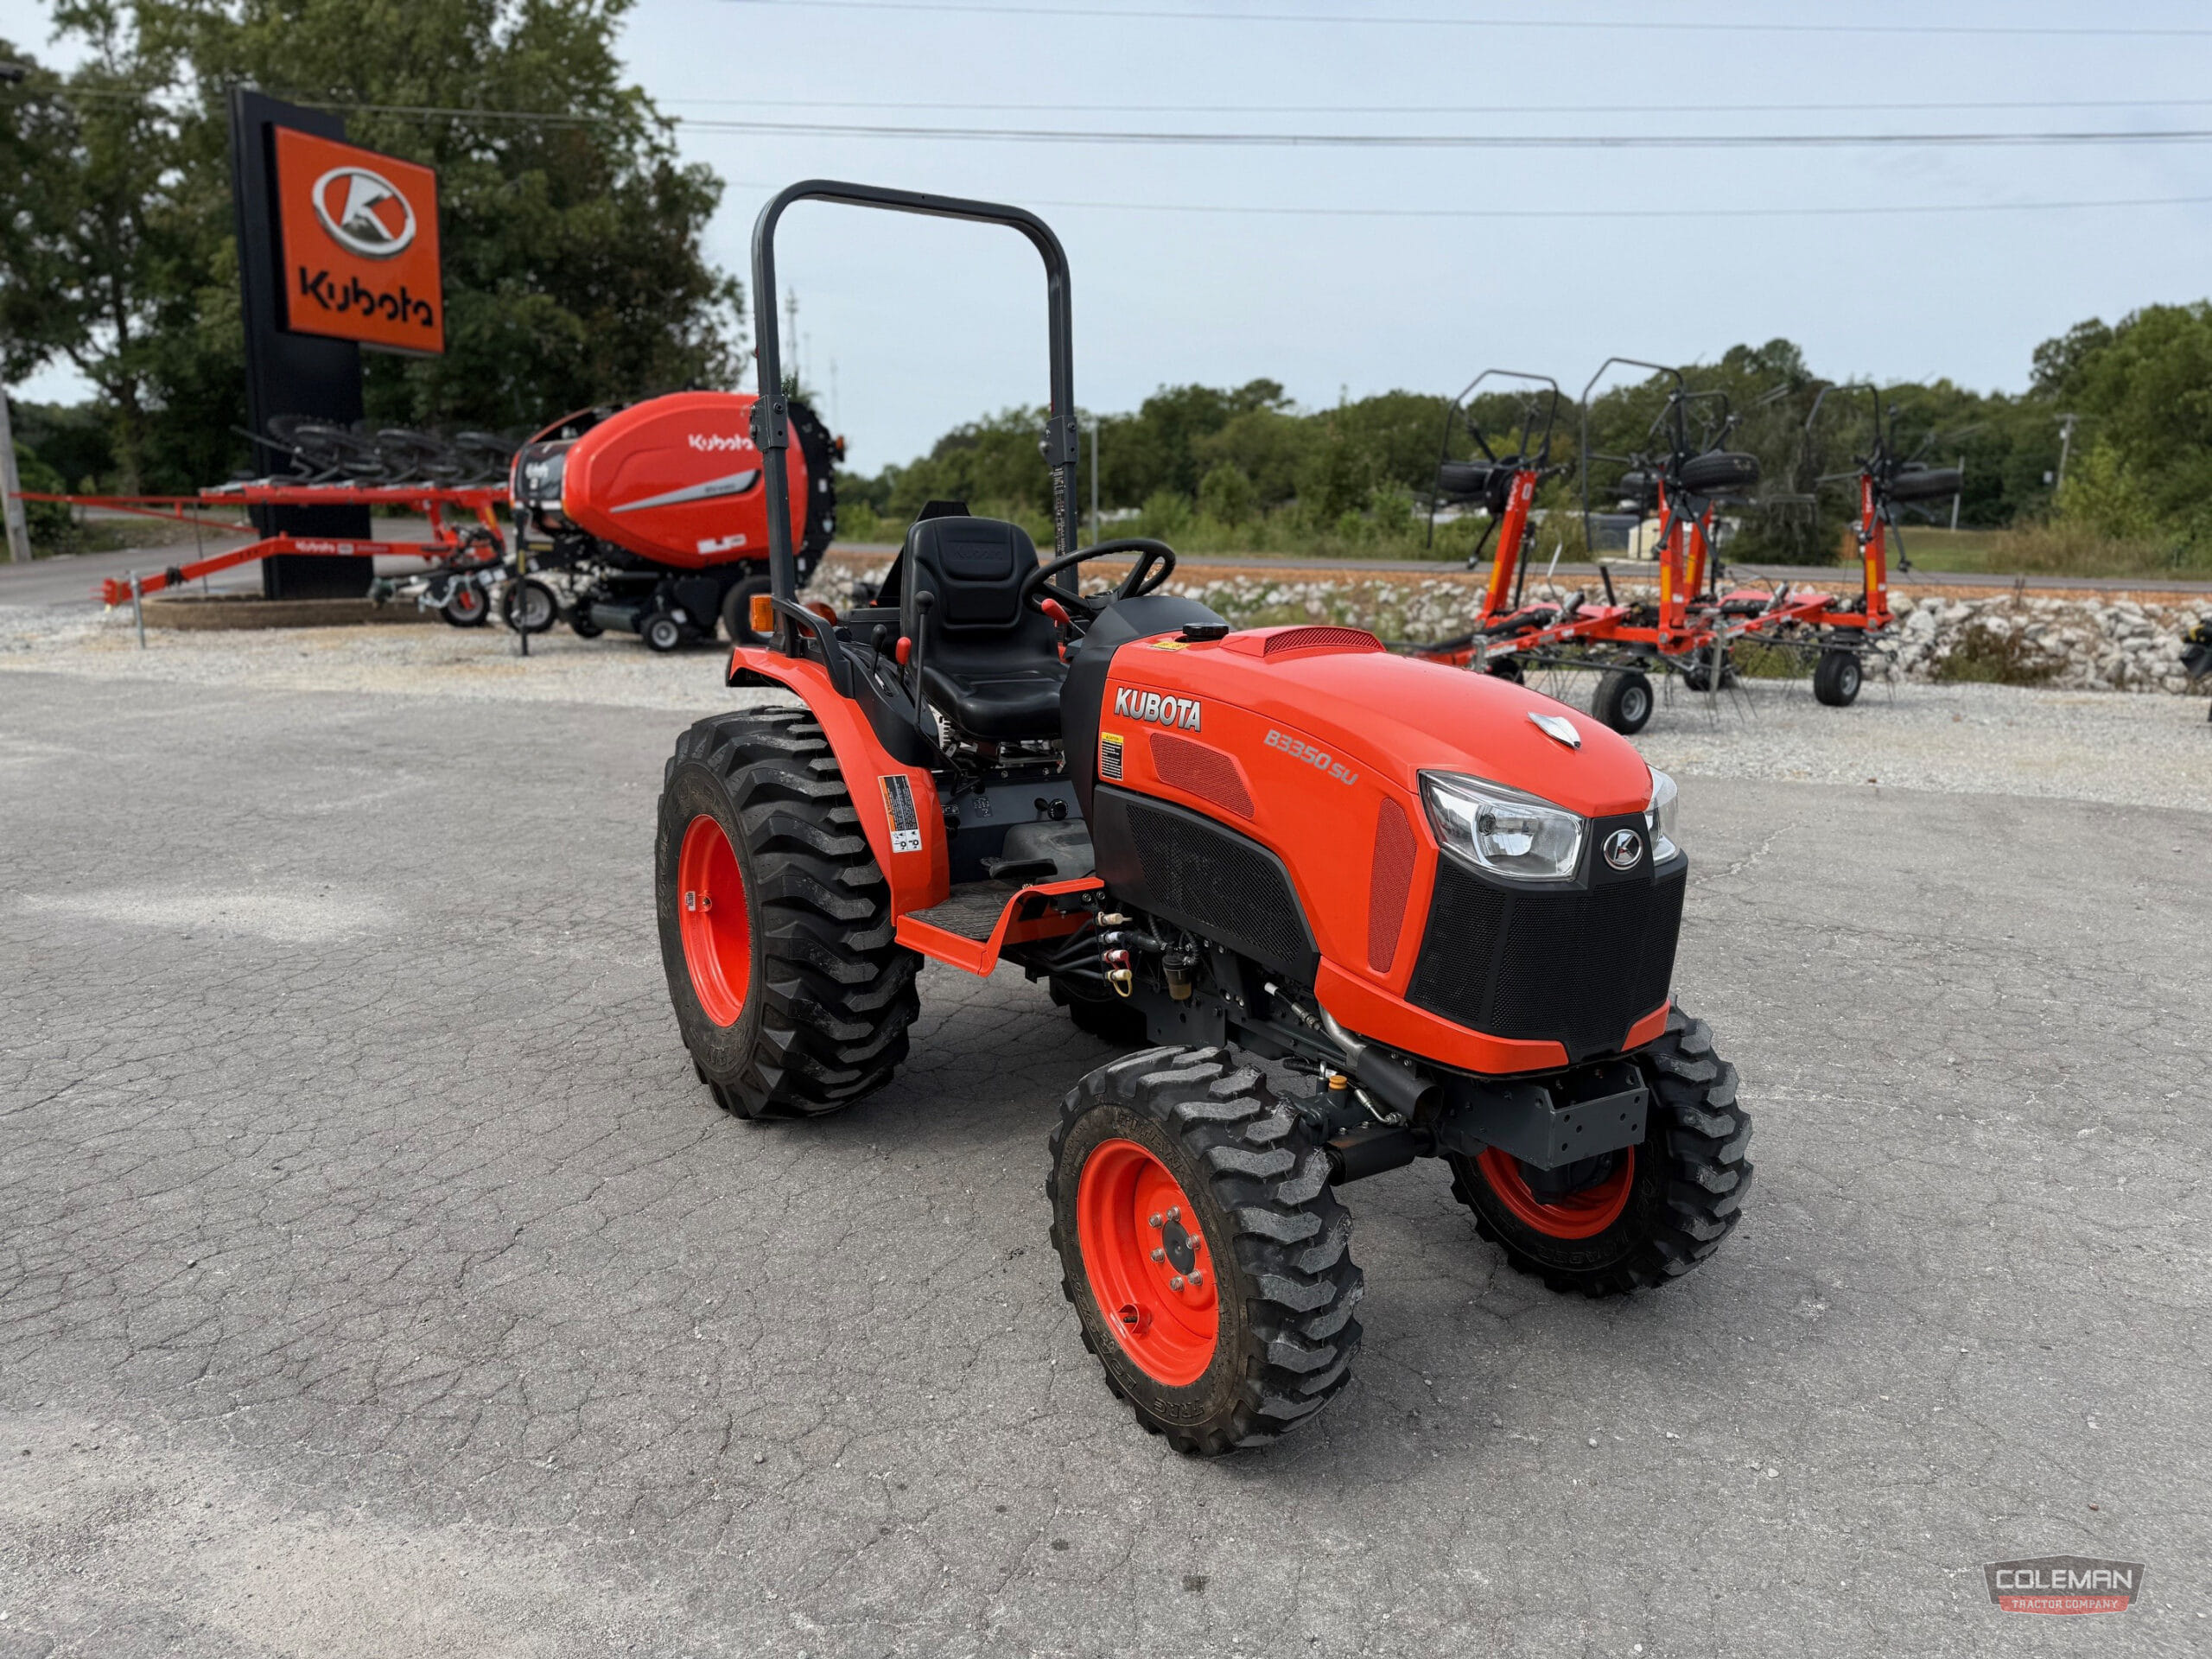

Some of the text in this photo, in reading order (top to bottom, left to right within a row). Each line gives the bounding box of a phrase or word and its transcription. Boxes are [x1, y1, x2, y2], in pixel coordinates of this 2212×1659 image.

[299, 267, 434, 327] Kubota
[688, 434, 754, 451] Kubota
[1114, 686, 1201, 733] KUBOTA
[1264, 729, 1358, 785] B3350 SU
